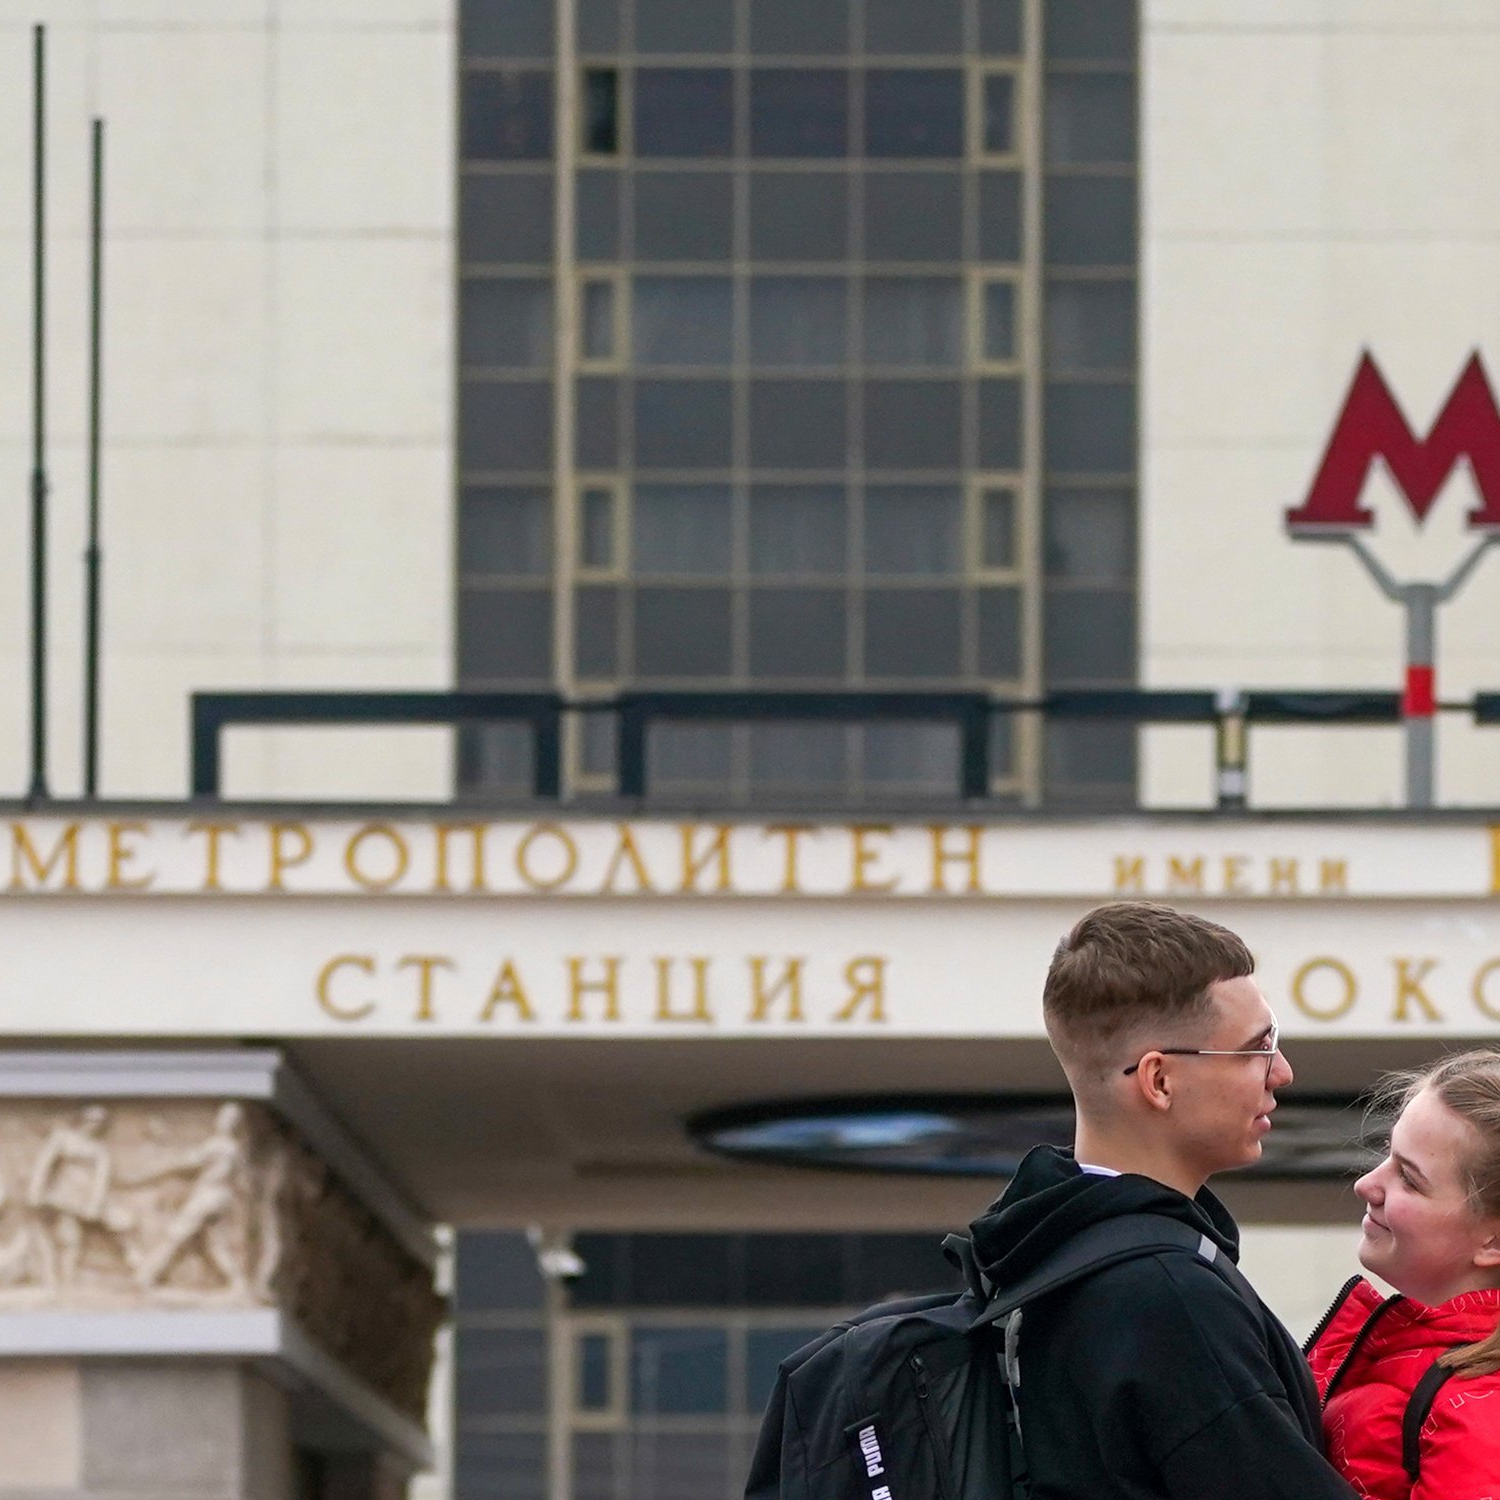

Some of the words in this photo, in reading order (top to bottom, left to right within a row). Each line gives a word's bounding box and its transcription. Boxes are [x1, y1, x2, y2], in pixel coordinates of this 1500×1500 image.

[8, 822, 986, 892] МЕТРОПОЛИТЕН
[314, 954, 892, 1023] СТАНЦИЯ
[858, 1425, 885, 1478] PUMA
